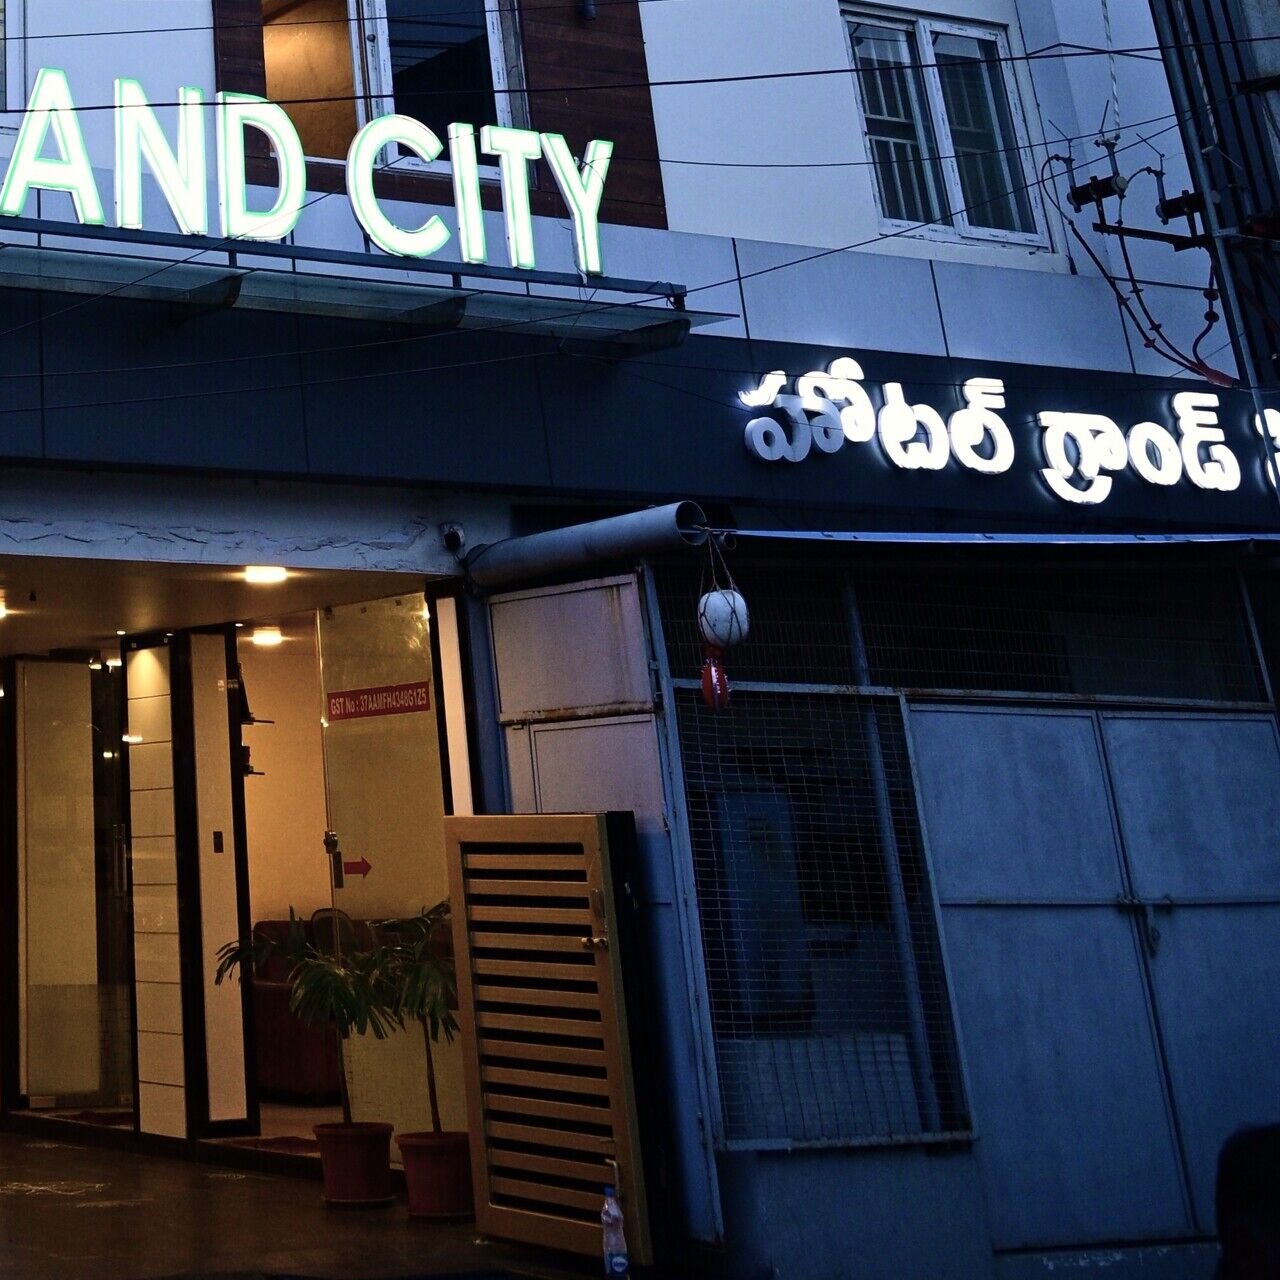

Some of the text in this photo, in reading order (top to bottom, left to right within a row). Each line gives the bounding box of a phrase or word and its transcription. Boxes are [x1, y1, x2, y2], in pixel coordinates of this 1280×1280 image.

[346, 113, 615, 276] CITY
[1037, 392, 1241, 504] గ్రాండ్
[331, 697, 344, 715] GST
